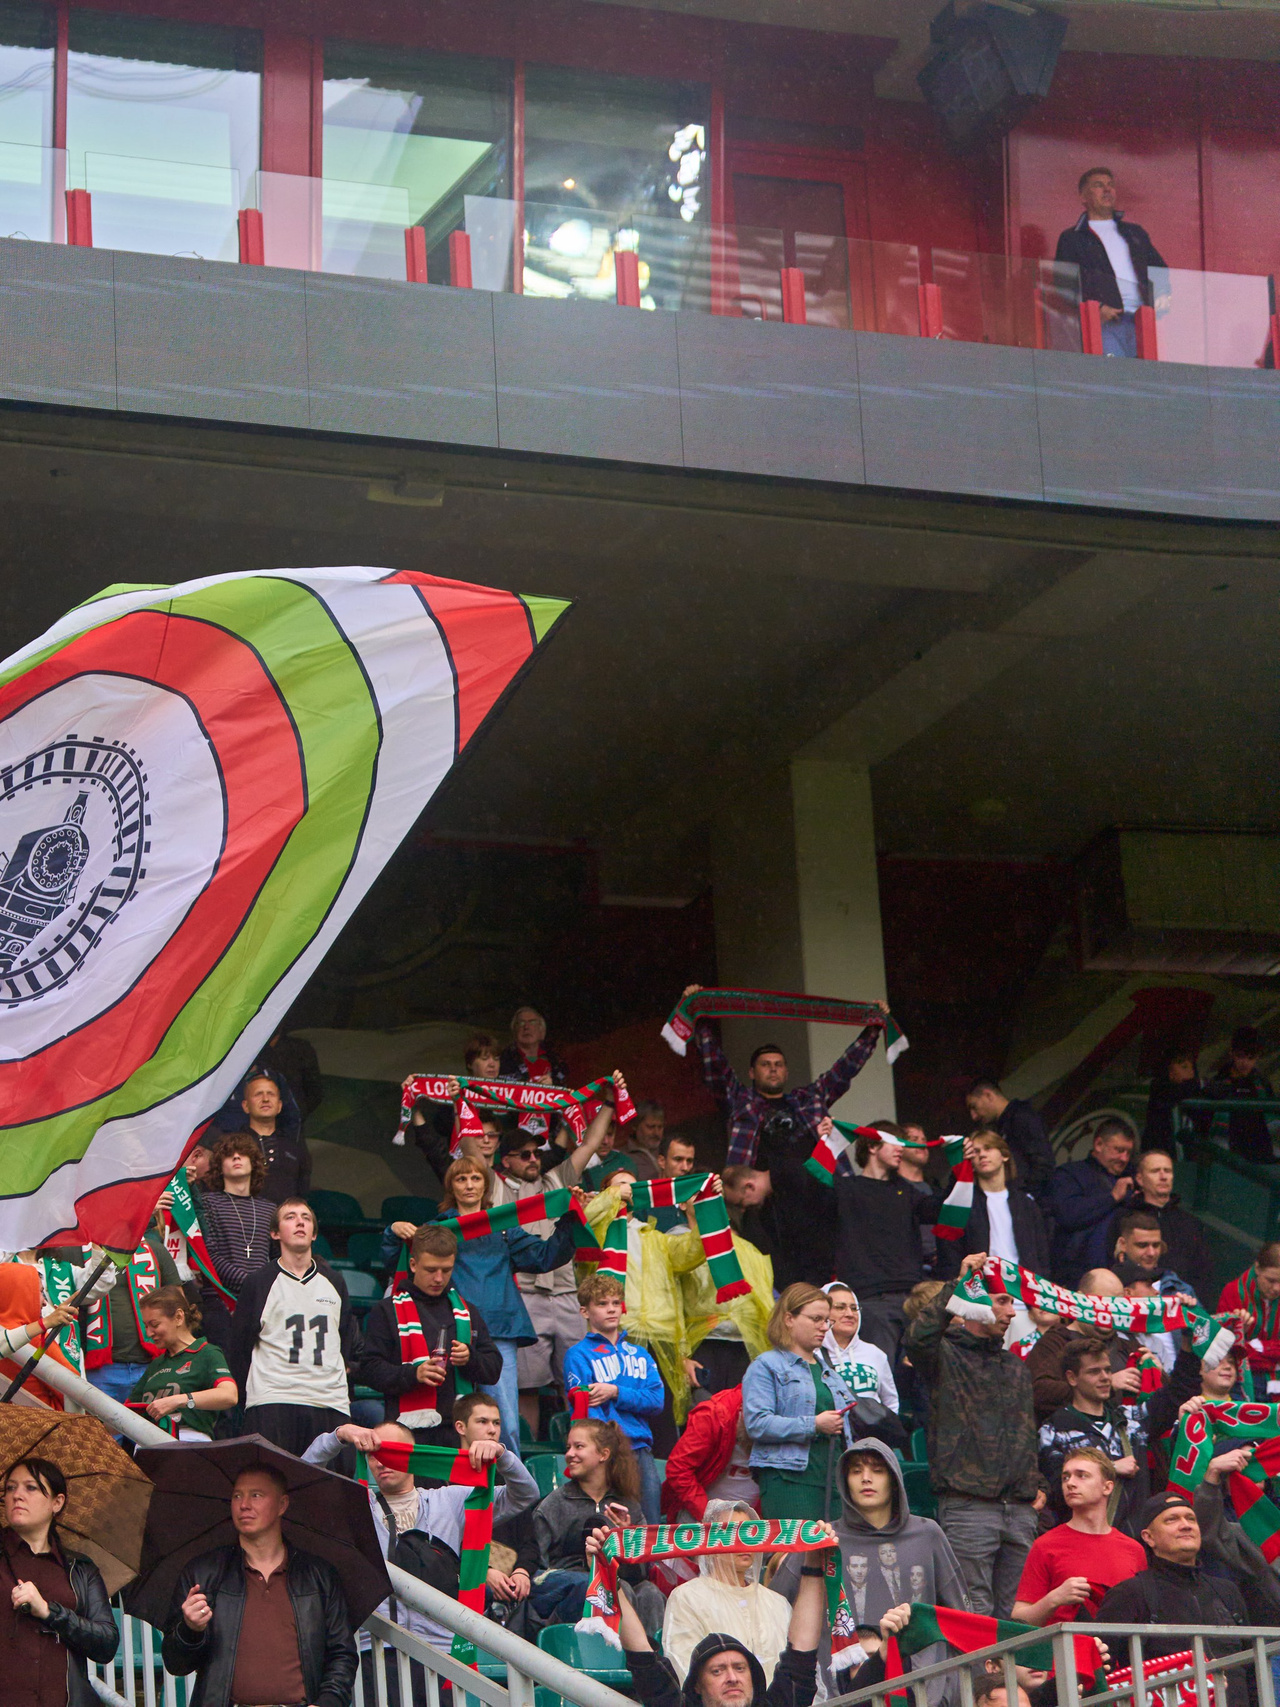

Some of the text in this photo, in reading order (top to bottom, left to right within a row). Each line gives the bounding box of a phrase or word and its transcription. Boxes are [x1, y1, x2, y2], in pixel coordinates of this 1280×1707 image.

[425, 1081, 515, 1099] LOMOTIV
[169, 1175, 192, 1212] ЧЕРК
[983, 1257, 1182, 1318] FC LOKOMOTIV
[1034, 1291, 1136, 1328] MOSCOW
[285, 1313, 329, 1366] 11
[590, 1352, 647, 1383] OLIMICO
[1175, 1401, 1280, 1476] LOKO
